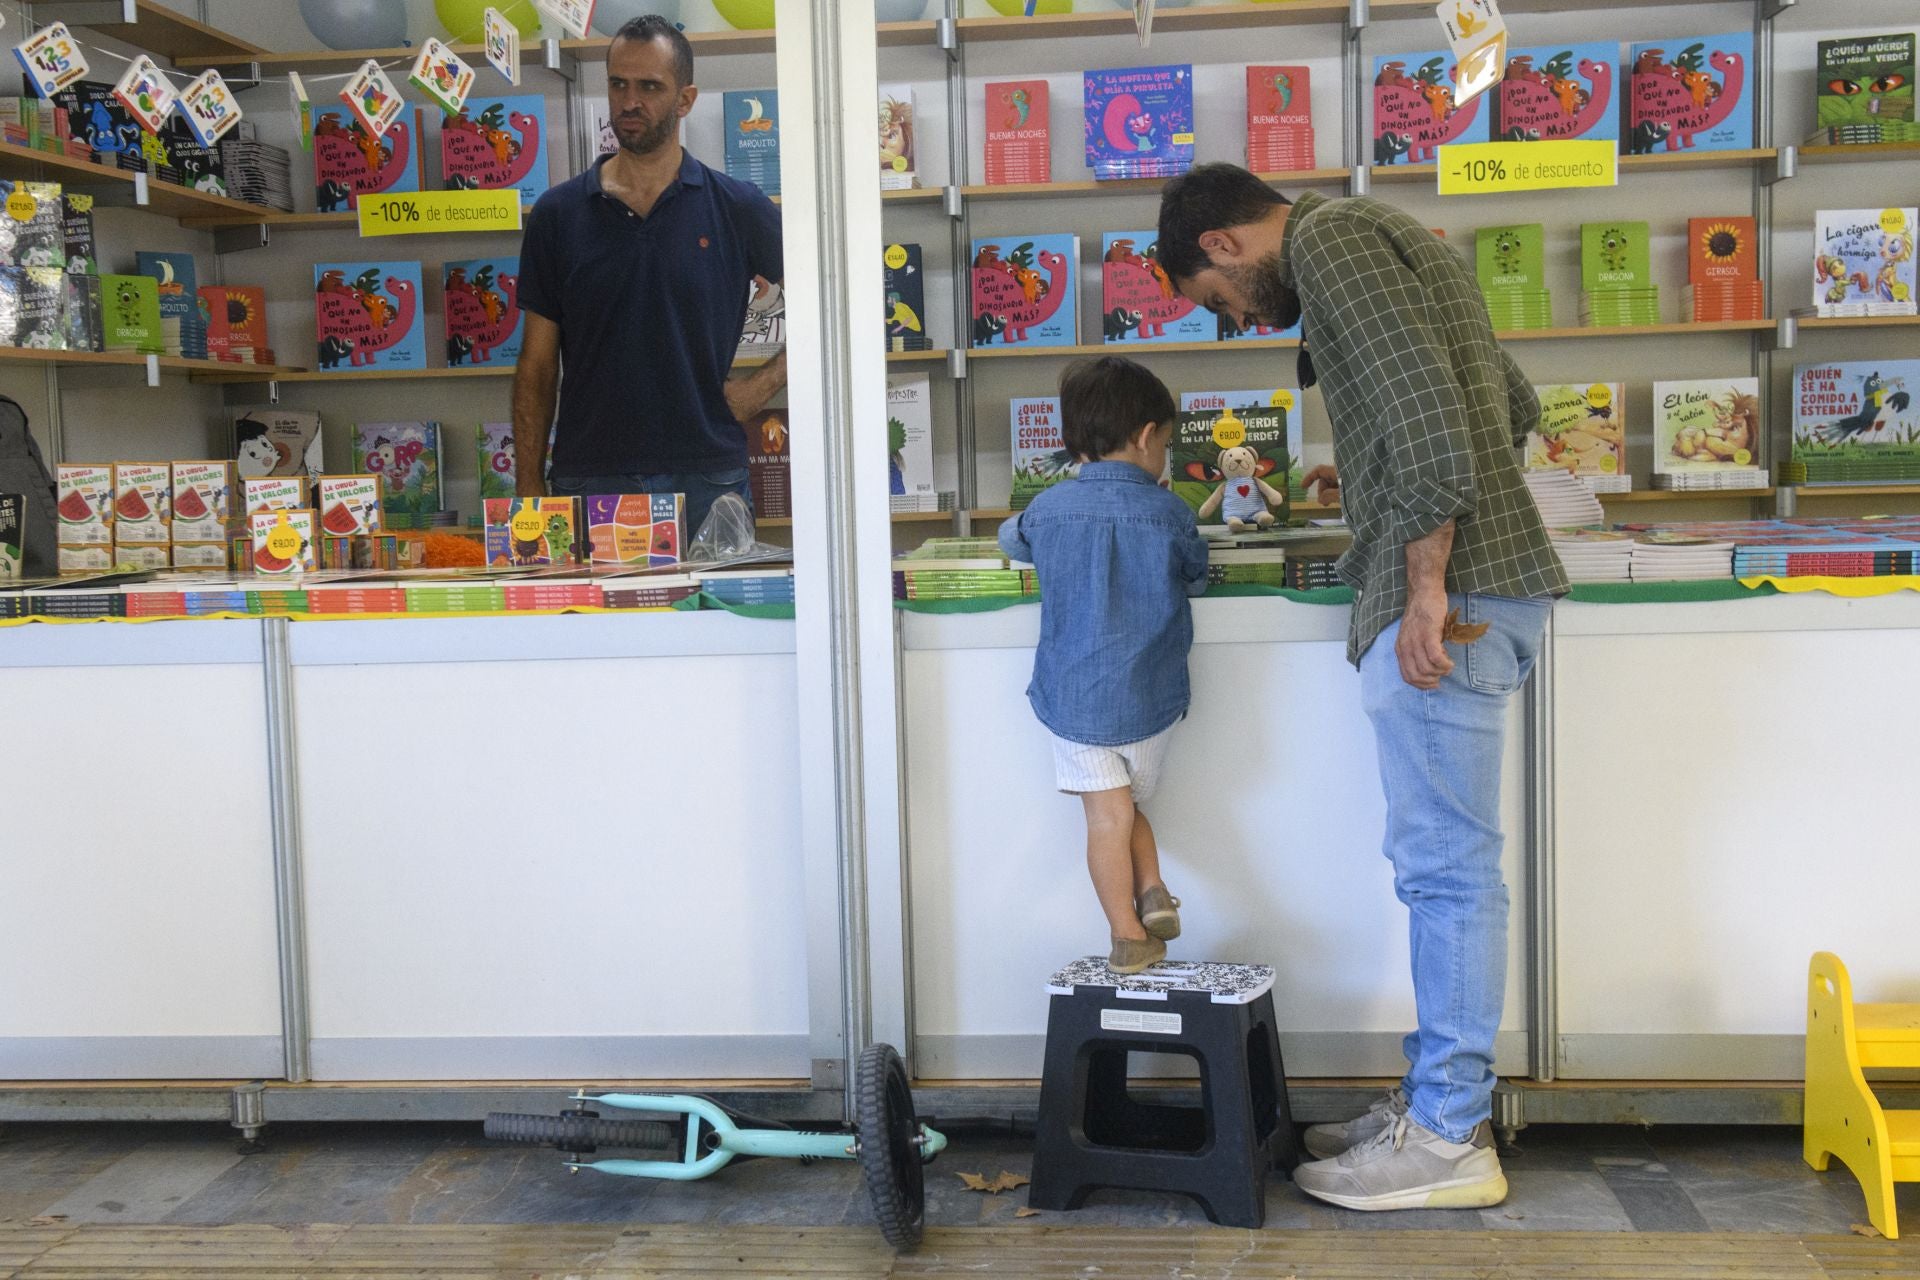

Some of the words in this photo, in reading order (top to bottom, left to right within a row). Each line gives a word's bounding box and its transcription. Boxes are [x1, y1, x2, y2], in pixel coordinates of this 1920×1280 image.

[1826, 45, 1864, 58] ¿QUIÉN
[1867, 41, 1909, 52] MUERDE
[35, 56, 46, 70] 1
[44, 47, 57, 62] 2
[56, 41, 71, 56] 3
[1875, 52, 1910, 62] VERDE?
[46, 60, 58, 72] 4
[56, 56, 69, 70] 5
[1666, 89, 1681, 97] NO
[195, 105, 205, 118] 1
[202, 94, 214, 110] 2
[212, 87, 225, 102] 3
[1536, 95, 1549, 104] NO
[1408, 101, 1421, 110] NO
[205, 109, 216, 120] 4
[214, 103, 226, 117] 5
[1638, 105, 1690, 119] DINOSAURIO
[1253, 115, 1278, 124] BUENAS
[1281, 115, 1309, 124] NOCHES
[1381, 117, 1431, 130] DINOSAURIO
[1507, 112, 1559, 125] DINOSAURIO
[990, 131, 1015, 140] BUENAS
[1018, 129, 1047, 138] NOCHES
[738, 138, 777, 149] BARQUITO
[1452, 159, 1507, 182] -10%
[1514, 162, 1529, 180] de
[1534, 160, 1603, 180] descuento
[371, 201, 420, 222] -10%
[427, 205, 441, 221] de
[446, 204, 509, 221] descuento
[1826, 226, 1843, 241] La
[1847, 223, 1880, 239] cigarr
[1837, 248, 1877, 261] hormiga
[1598, 272, 1635, 282] DRAGONA
[1705, 267, 1741, 277] GIRASOL
[1492, 274, 1528, 285] DRAGONA
[160, 304, 188, 312] ARQUITO
[115, 328, 148, 338] DRAGONA
[230, 334, 253, 342] RASOL
[207, 338, 228, 346] OCHES
[1801, 366, 1842, 382] ¿QUIÉN
[1801, 382, 1814, 392] SE
[1819, 381, 1836, 391] HA
[1188, 396, 1226, 410] ¿QUIÉN
[1663, 393, 1682, 409] El
[1685, 390, 1709, 404] león
[1801, 393, 1846, 404] COMIDO
[1850, 392, 1858, 403] A
[1018, 401, 1053, 415] ¿QUIÉN
[1553, 398, 1582, 410] zorra
[1679, 408, 1705, 422] ratón
[1801, 404, 1859, 416] ESTEBAN?
[1018, 416, 1030, 425] SE
[1034, 416, 1049, 425] HA
[1181, 418, 1216, 434] ¿QUIÉ
[1242, 417, 1279, 429] UERDE
[1549, 414, 1579, 429] cuervo
[1018, 427, 1058, 437] COMIDO
[1220, 431, 1240, 440] €9,00
[1018, 438, 1065, 449] ESTEBAN
[1194, 435, 1204, 443] LA
[259, 481, 282, 491] ORUGA
[335, 480, 358, 490] ORUGA
[248, 494, 259, 502] DE
[261, 486, 298, 499] VALORES
[324, 492, 336, 501] DE
[337, 484, 374, 498] VALORES
[256, 520, 266, 528] LA
[256, 529, 267, 538] DE
[273, 539, 295, 548] €9,00
